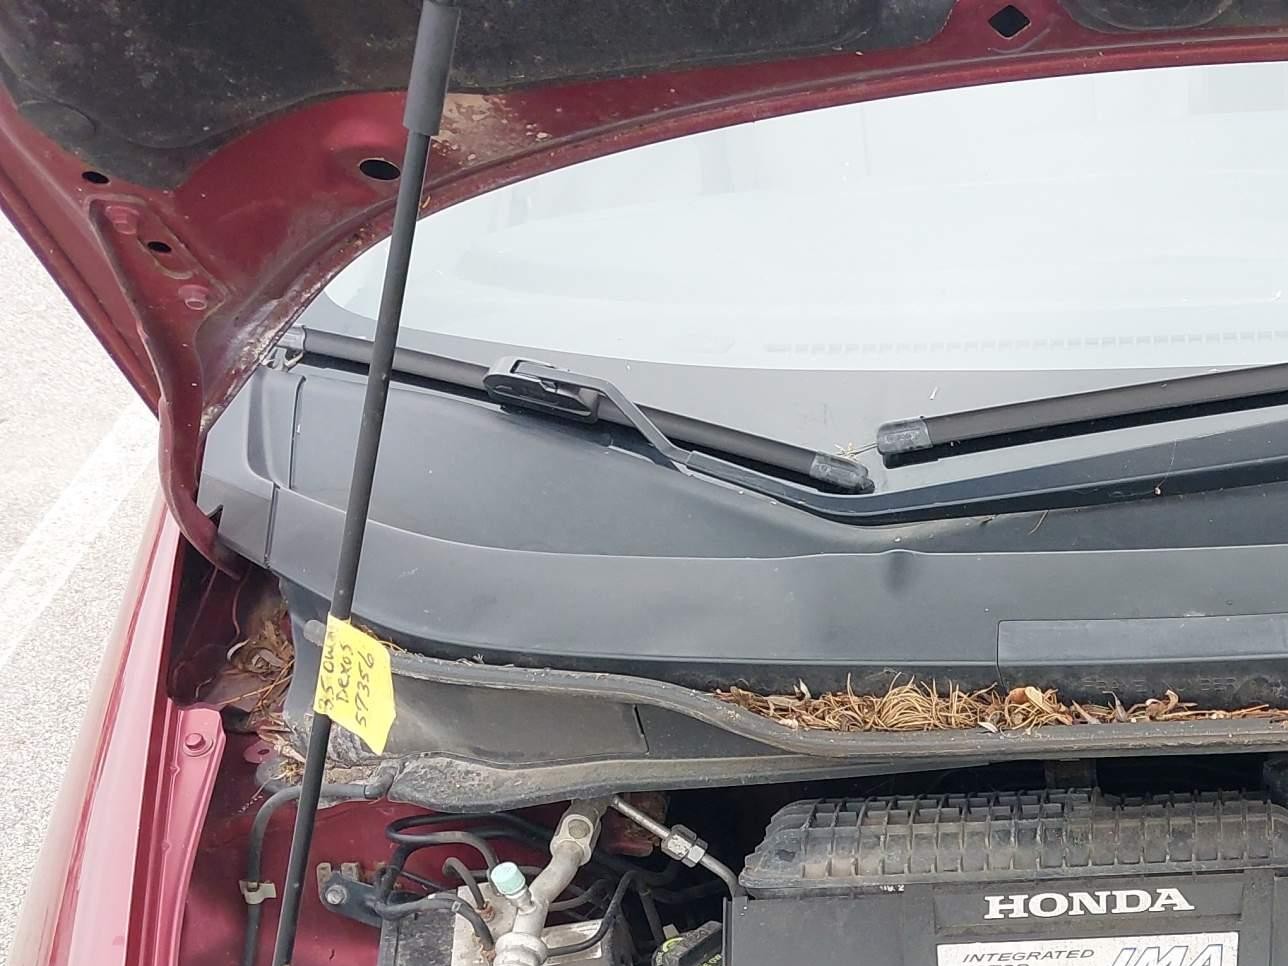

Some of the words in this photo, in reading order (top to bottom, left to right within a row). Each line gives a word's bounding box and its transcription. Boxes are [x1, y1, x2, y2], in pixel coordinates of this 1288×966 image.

[354, 650, 375, 729] 57356
[984, 887, 1195, 919] HONDA
[962, 949, 1095, 963] INTEGRATED
